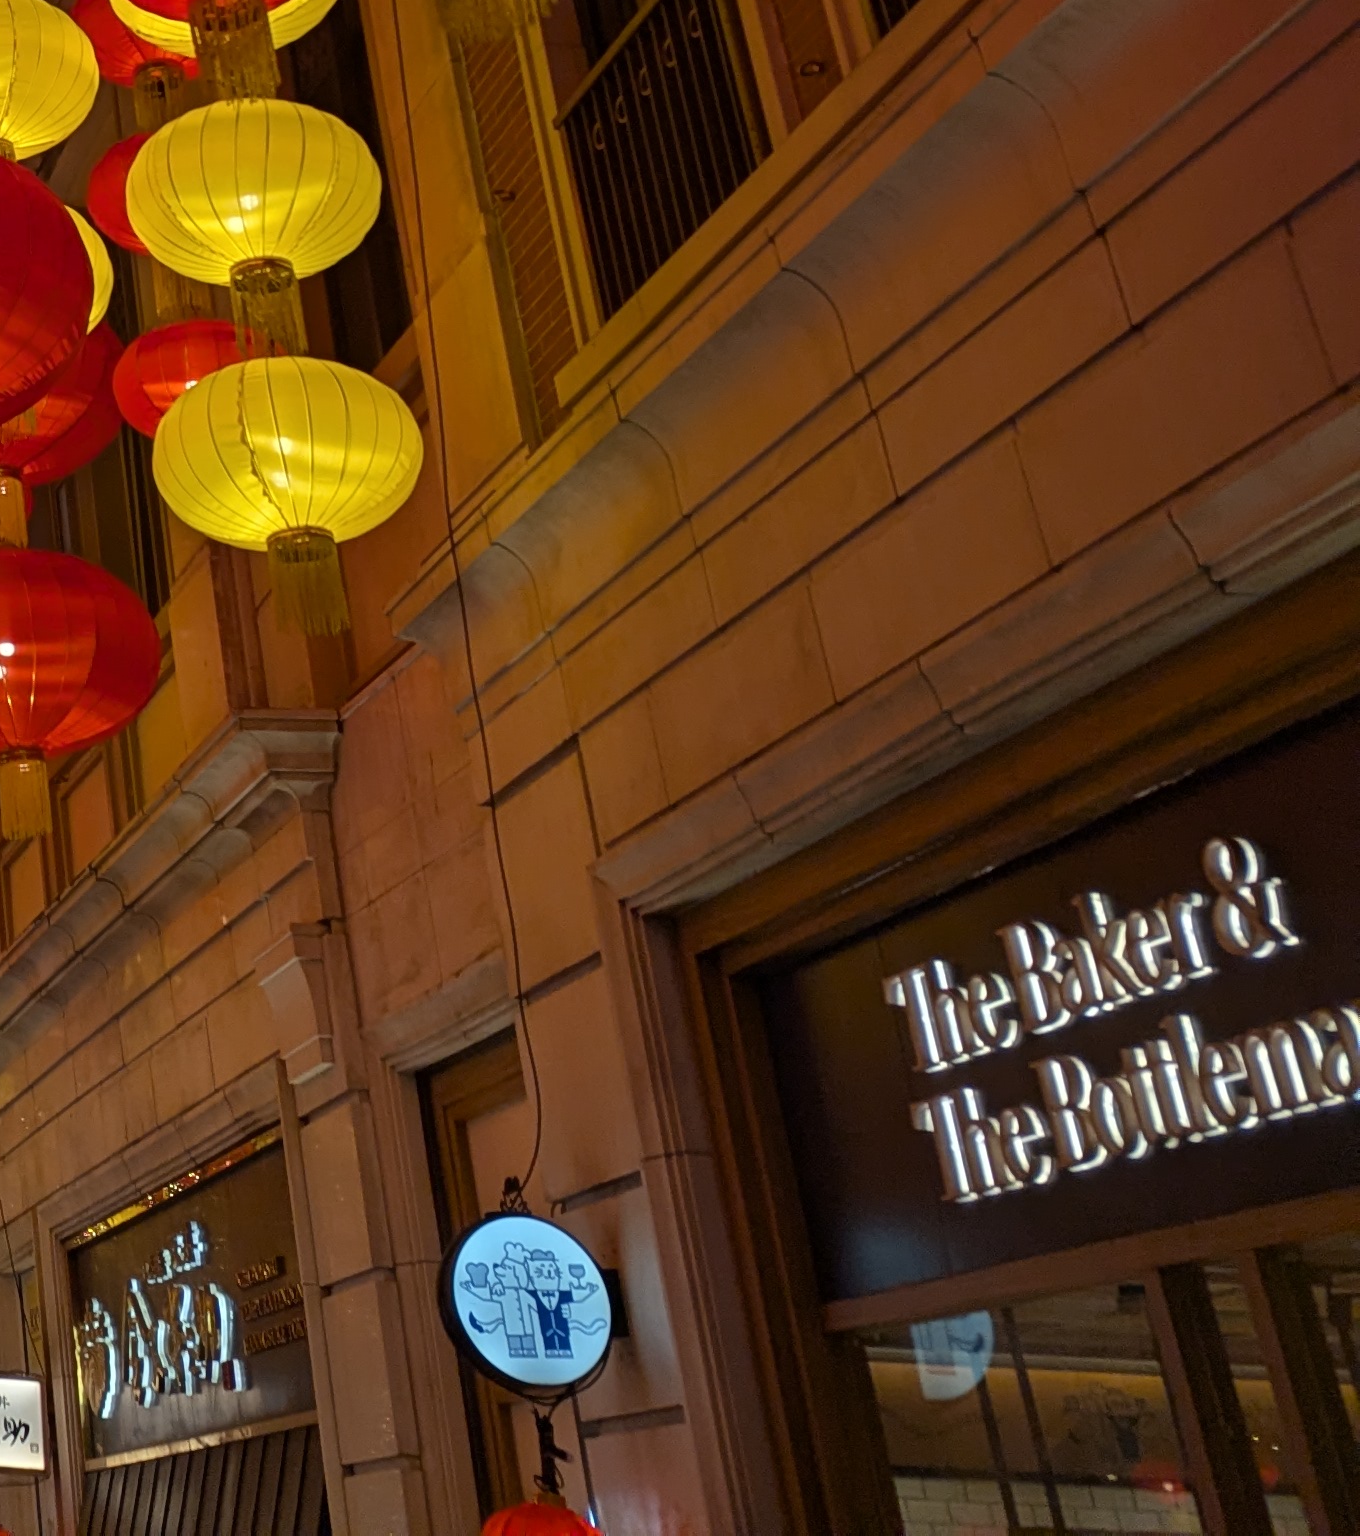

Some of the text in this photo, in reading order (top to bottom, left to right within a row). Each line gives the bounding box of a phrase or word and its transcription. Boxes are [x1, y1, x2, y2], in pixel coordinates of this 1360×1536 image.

[882, 836, 1304, 1074] The Baker &
[909, 1087, 1057, 1203] The
